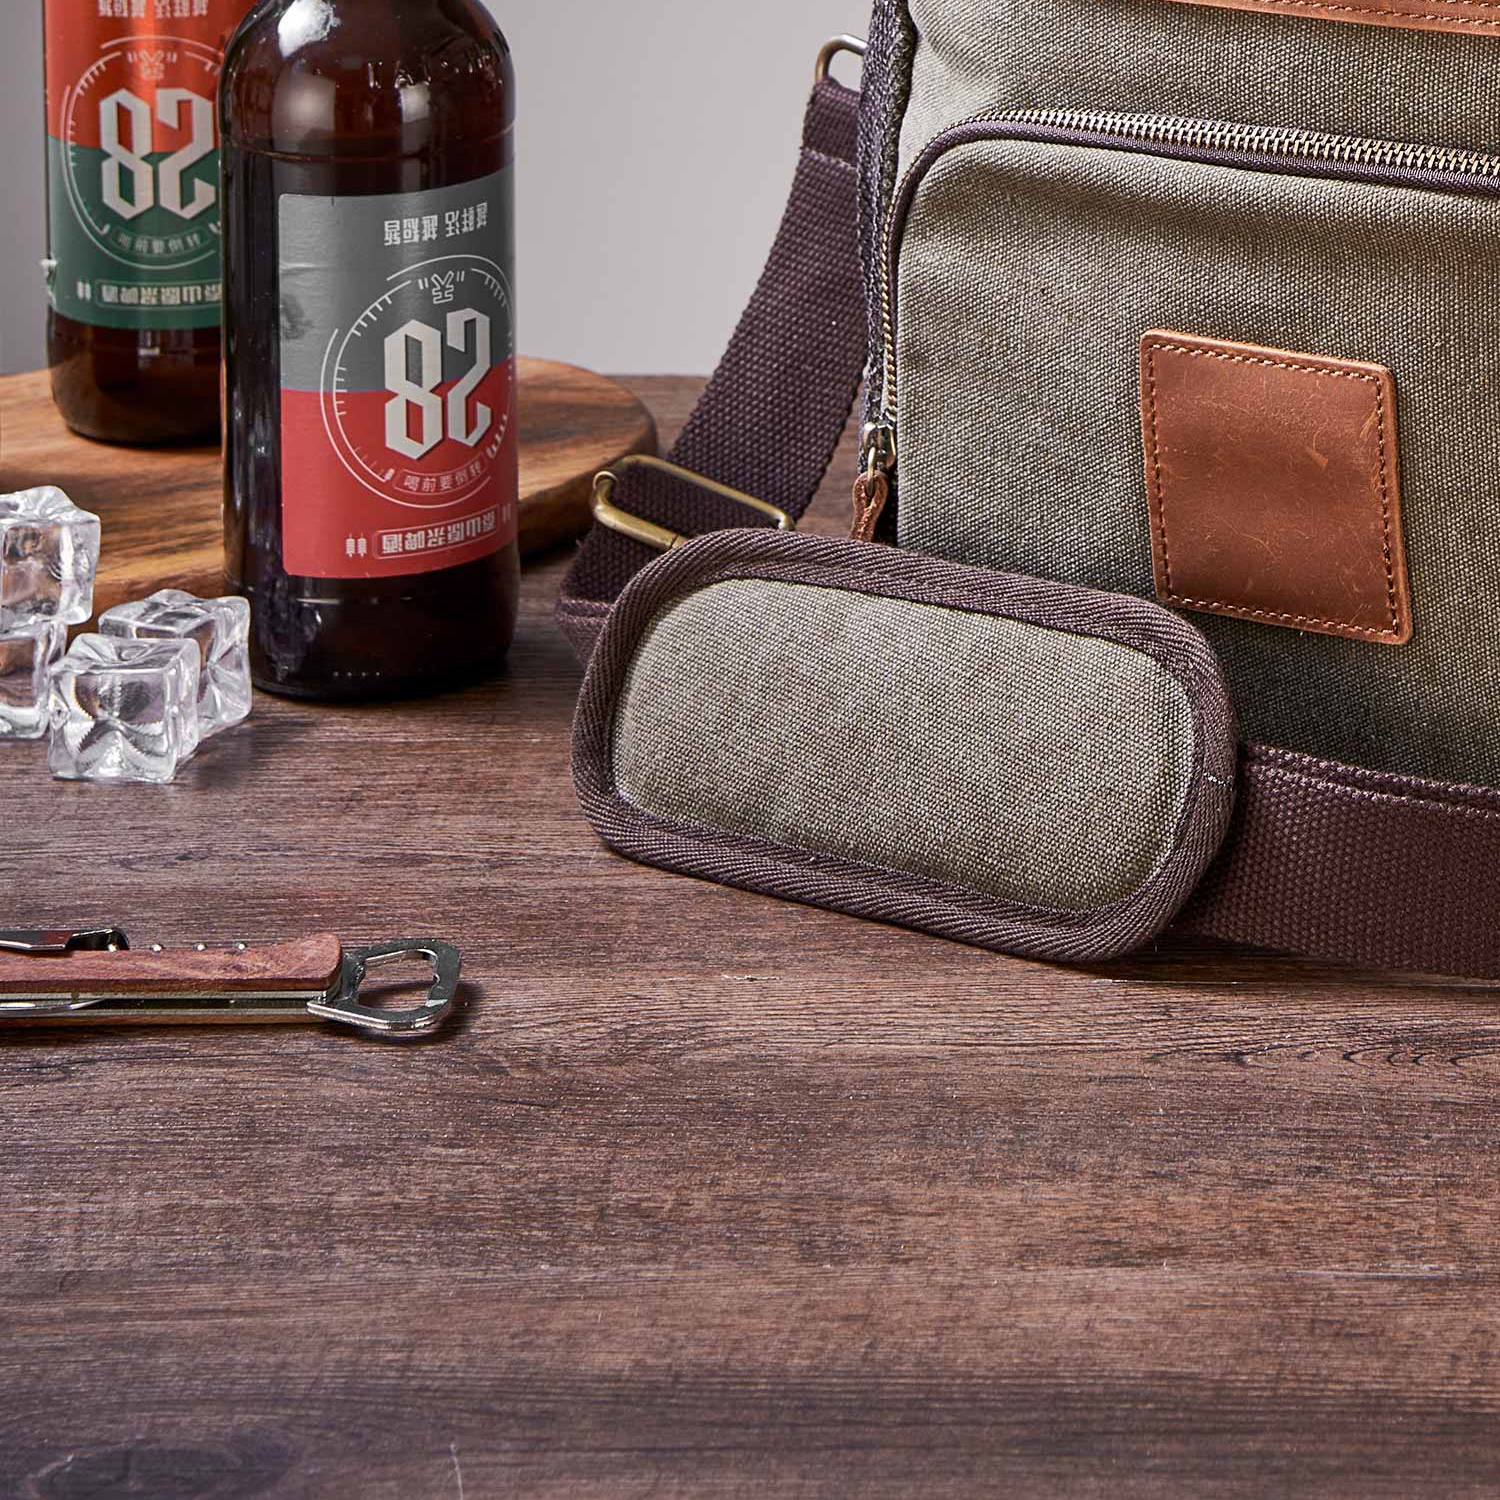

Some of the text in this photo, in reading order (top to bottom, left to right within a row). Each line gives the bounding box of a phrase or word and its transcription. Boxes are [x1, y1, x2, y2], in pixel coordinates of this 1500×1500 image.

[381, 511, 497, 554] 泰山原浆啤酒
